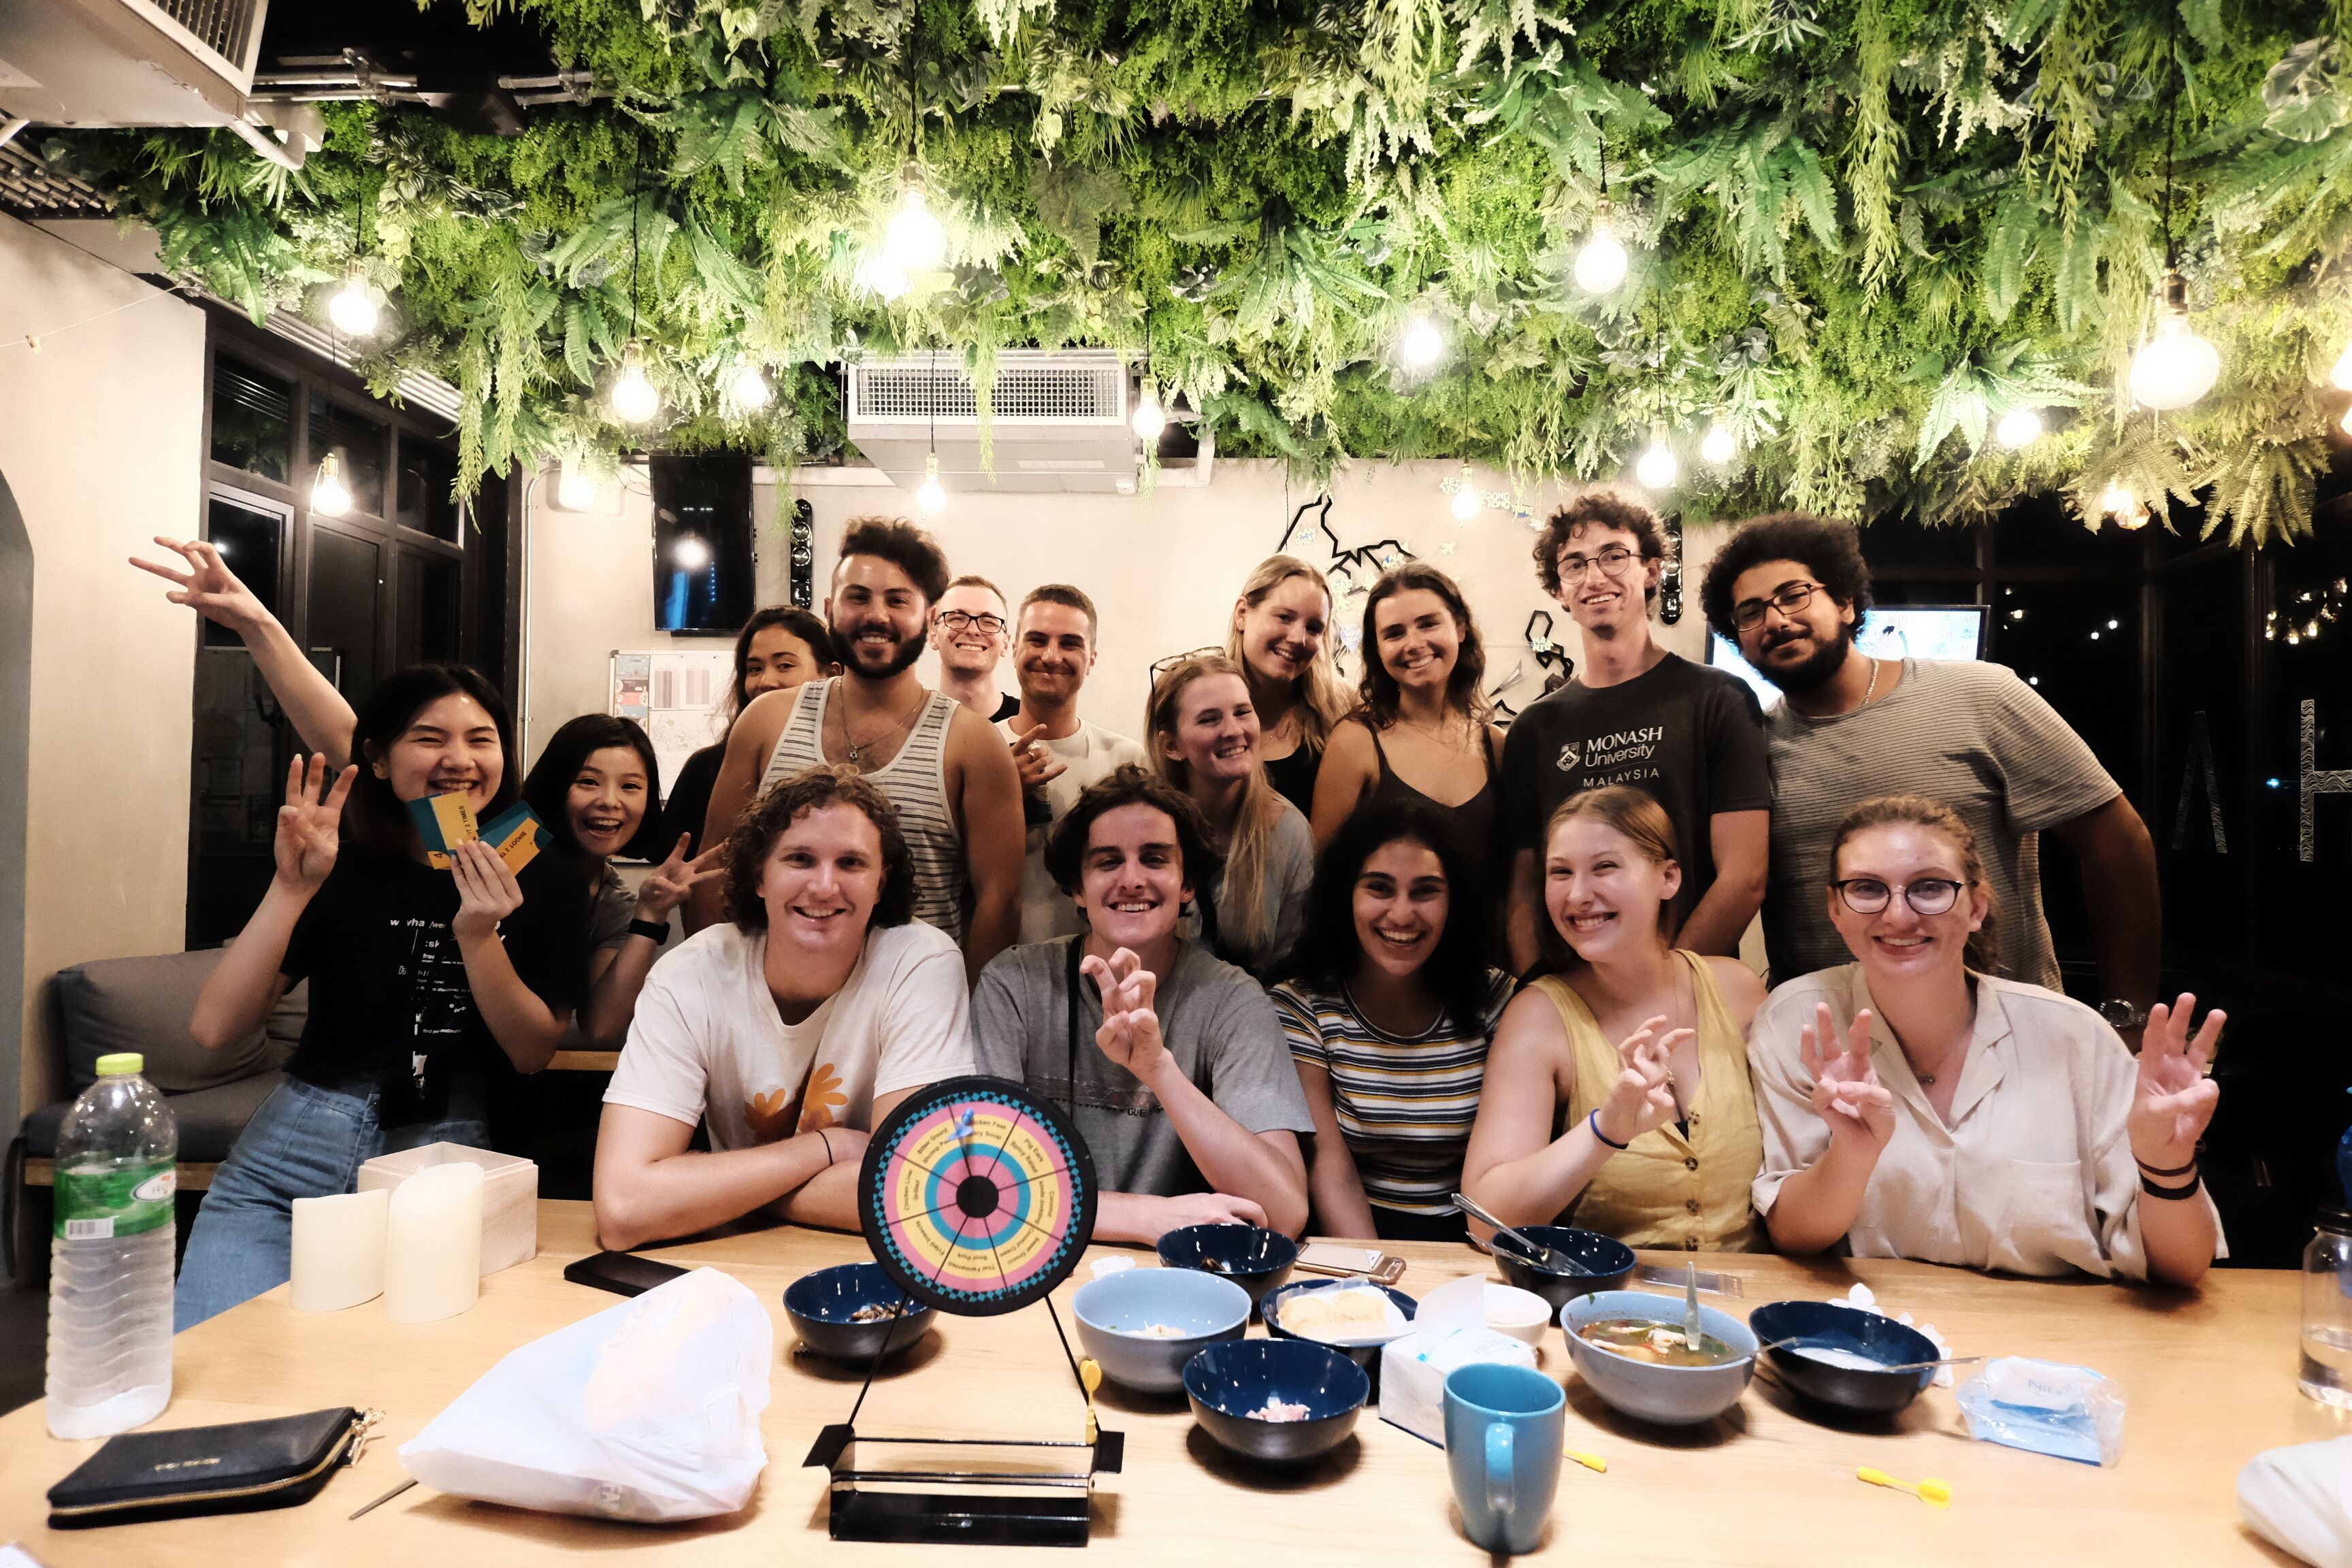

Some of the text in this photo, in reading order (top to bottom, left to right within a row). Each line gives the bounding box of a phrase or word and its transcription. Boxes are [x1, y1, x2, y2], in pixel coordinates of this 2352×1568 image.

[1586, 726, 1663, 753] MONASH
[1584, 745, 1656, 767] University
[1583, 768, 1660, 788] MALAYSIA
[510, 831, 527, 849] SHOOT
